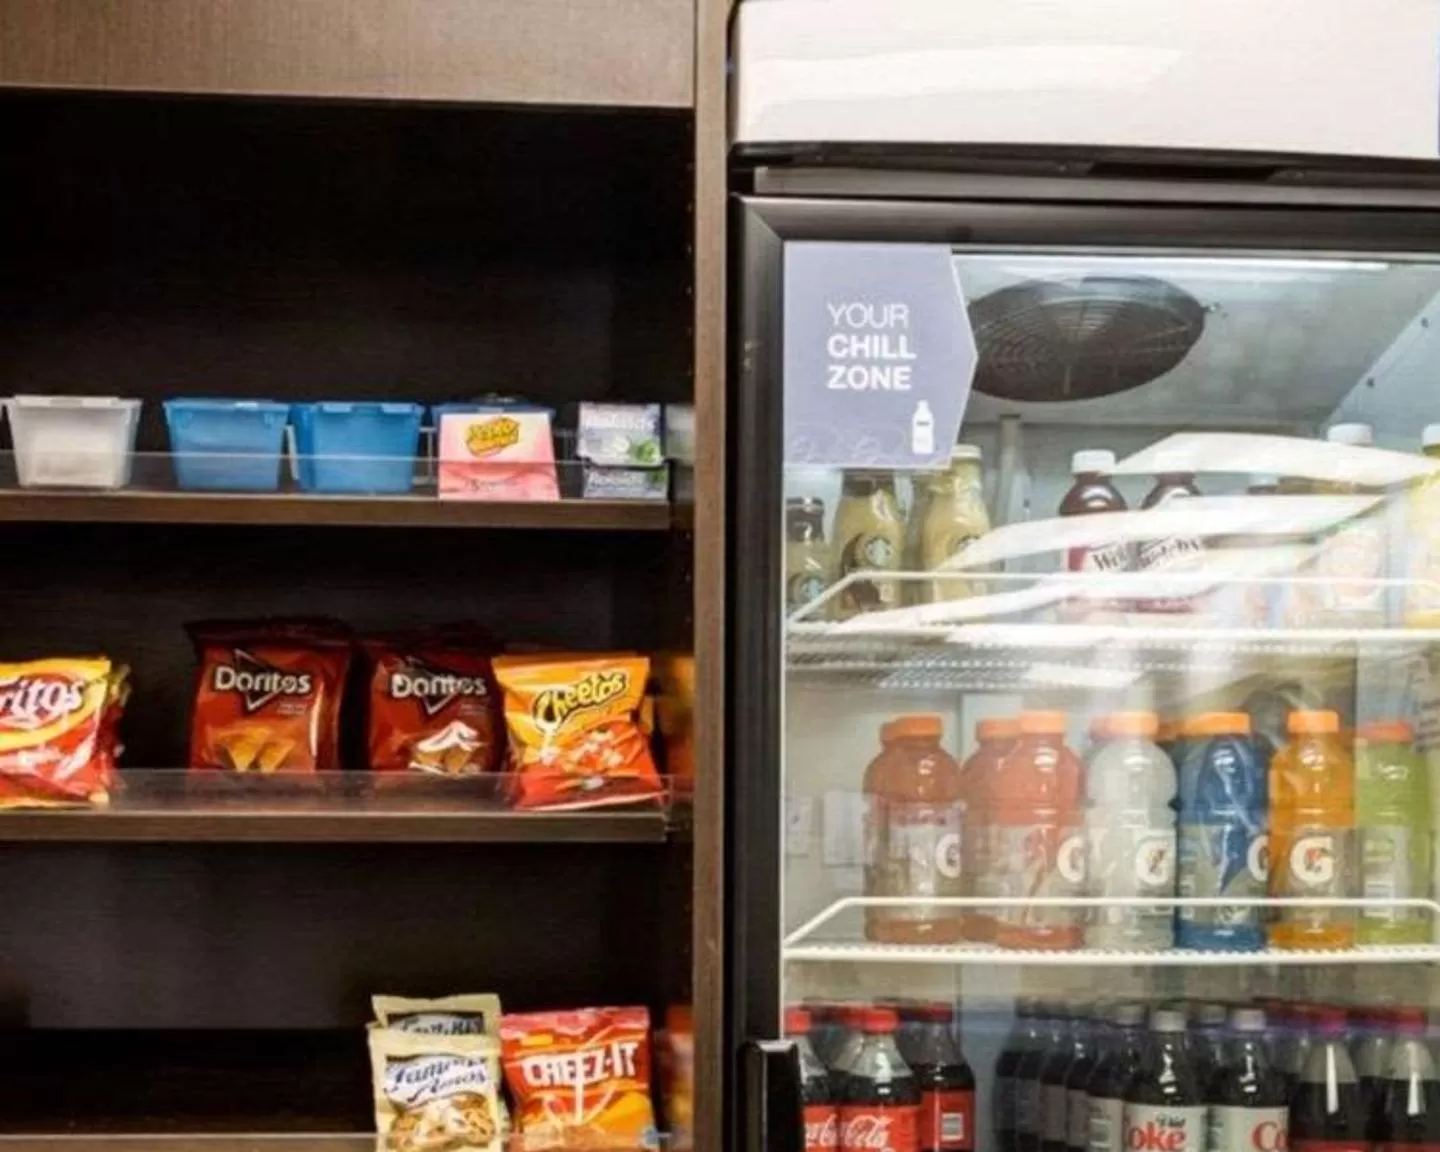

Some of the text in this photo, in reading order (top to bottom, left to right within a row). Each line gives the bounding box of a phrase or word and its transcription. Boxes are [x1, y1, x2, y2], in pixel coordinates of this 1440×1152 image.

[827, 303, 910, 328] YOUR
[827, 334, 917, 360] CHILL
[827, 365, 912, 391] ZONE
[215, 666, 312, 694] Doritos
[392, 672, 488, 698] Doritos
[0, 677, 84, 724] ritos
[533, 669, 629, 730] Cheetos
[1290, 836, 1334, 884] G
[522, 1041, 640, 1087] CHEEZ-IT
[1124, 1121, 1187, 1152] oke
